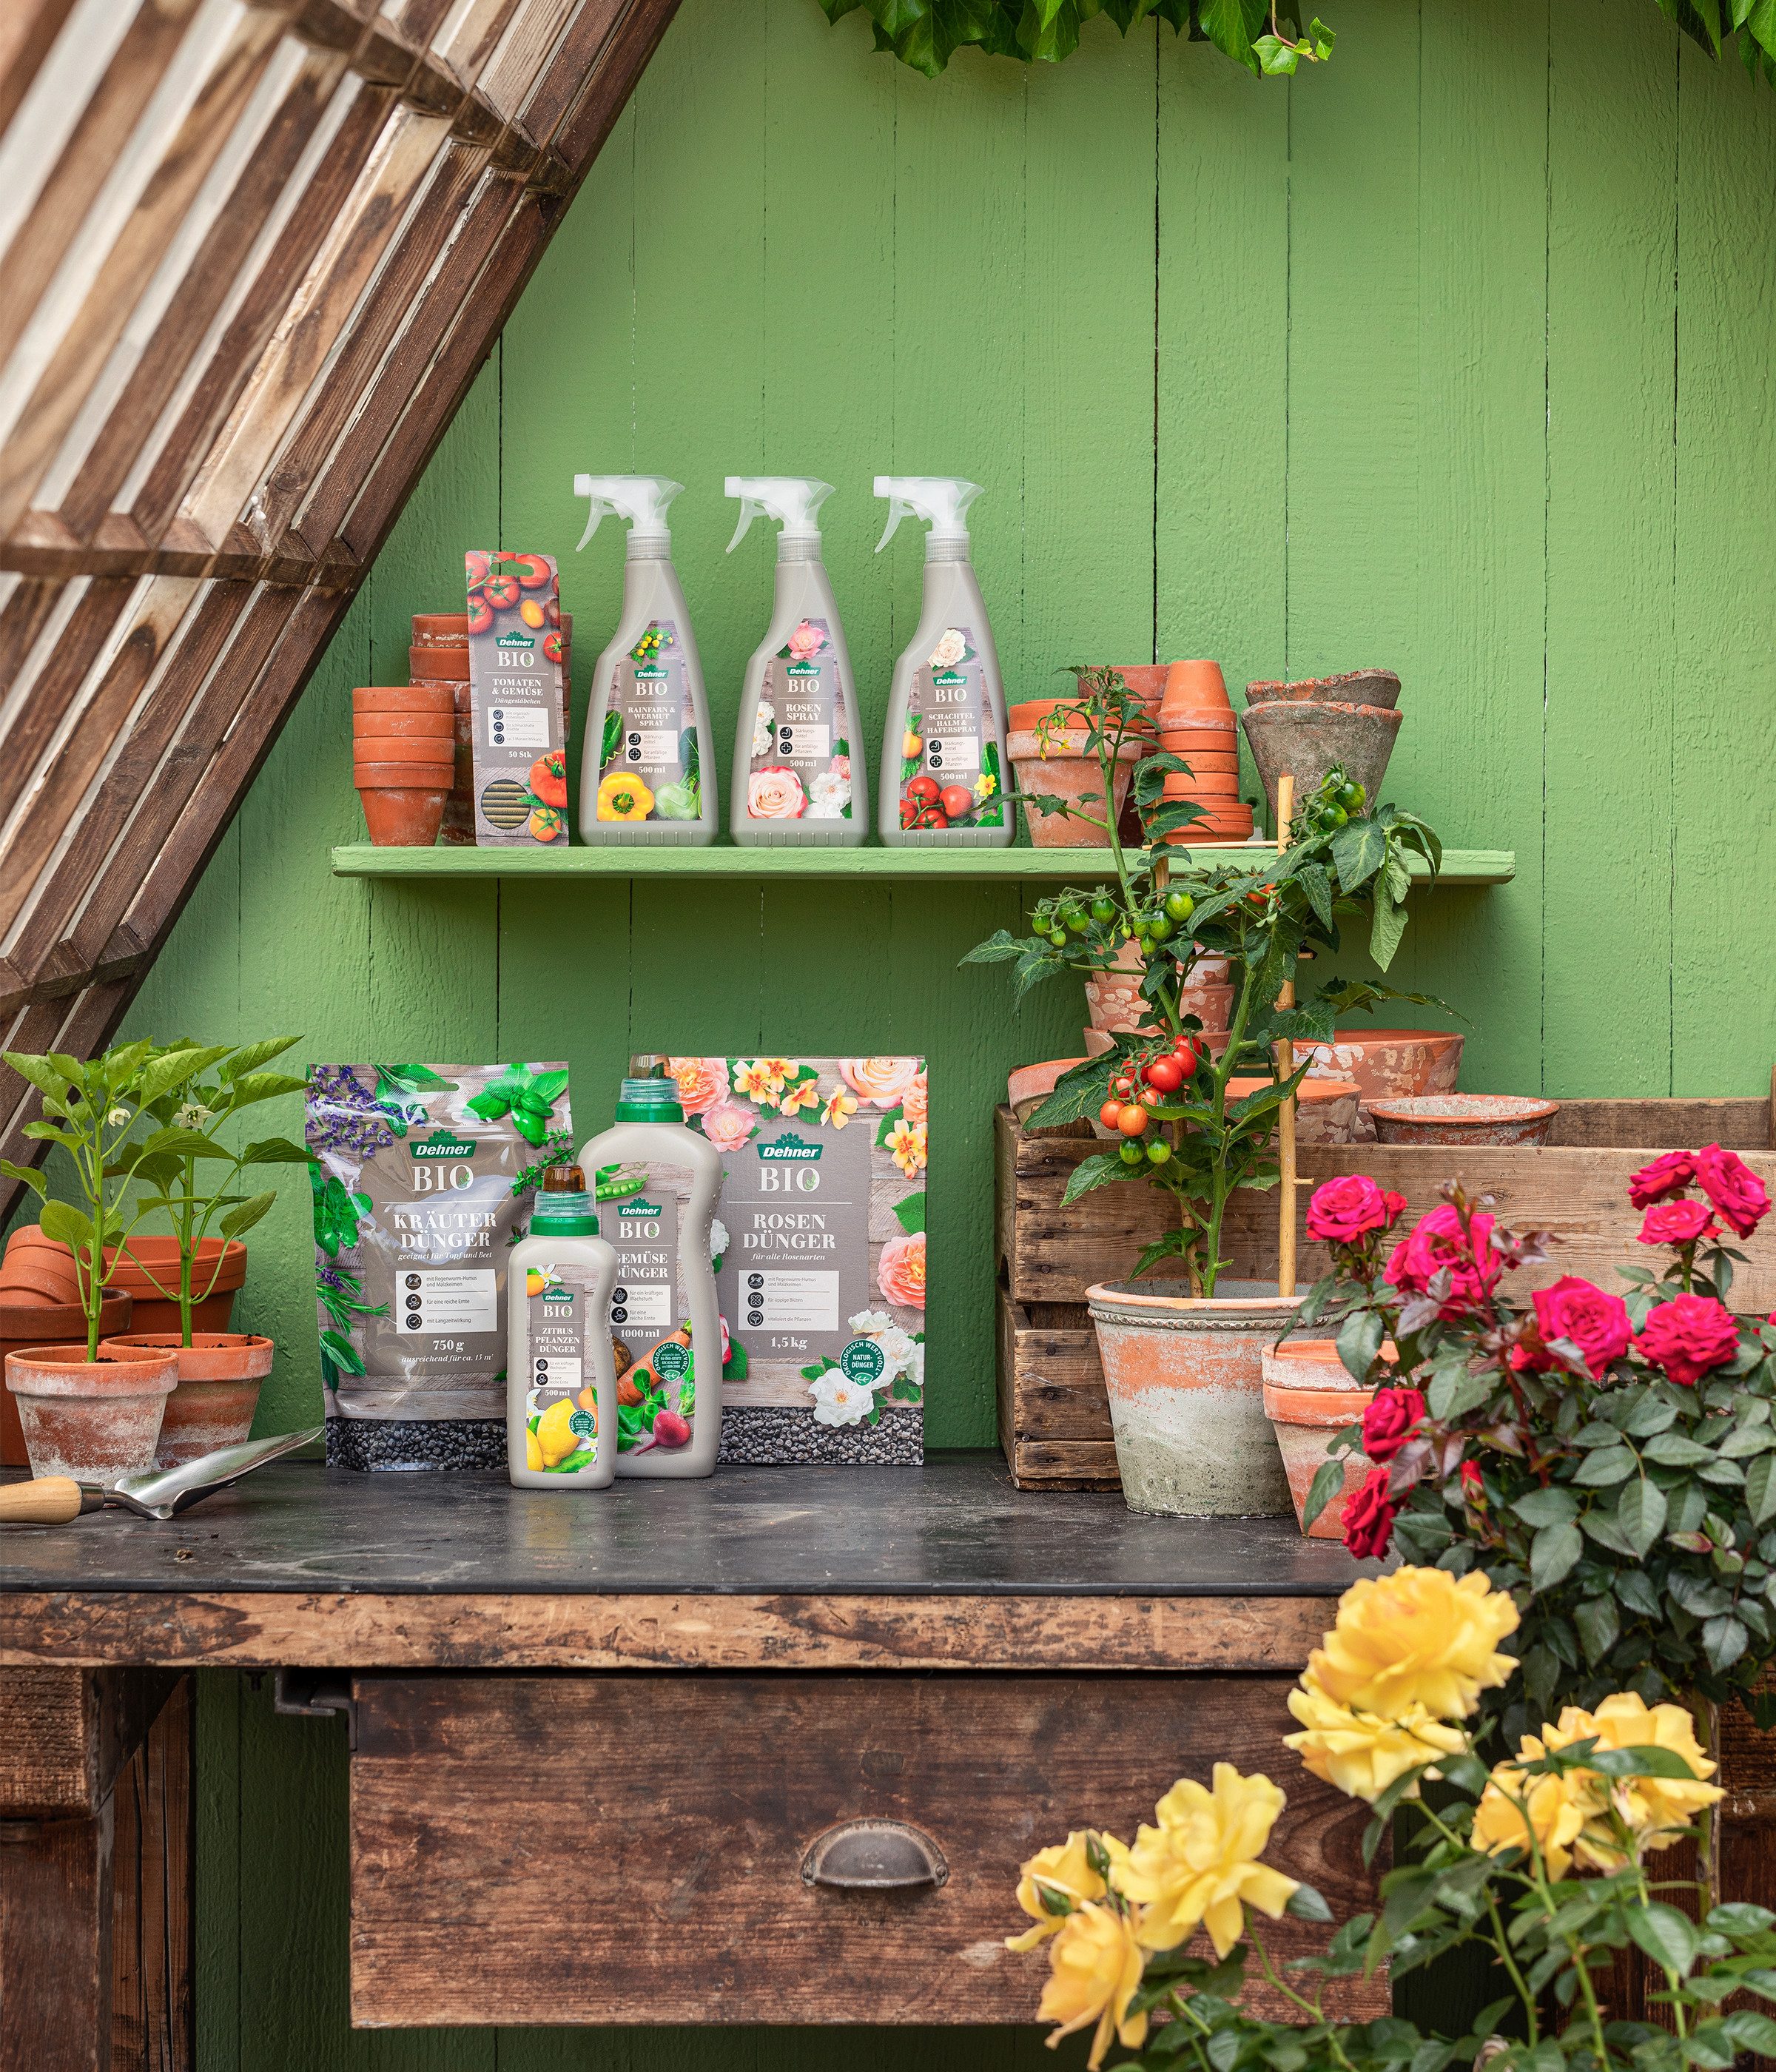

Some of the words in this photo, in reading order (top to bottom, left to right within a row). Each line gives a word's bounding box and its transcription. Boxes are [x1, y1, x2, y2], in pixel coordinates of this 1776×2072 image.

[497, 651, 534, 667] BIO
[492, 678, 542, 687] TOMATEN
[636, 682, 667, 696] BIO
[787, 679, 820, 693] BIO
[502, 687, 543, 696] GEMÜSE
[935, 688, 967, 702] BIO
[786, 704, 821, 712] ROSEN
[787, 712, 820, 721] SPRAY
[519, 750, 532, 758] Stk
[416, 1144, 472, 1156] Dehner
[763, 1146, 819, 1158] Dehner
[411, 1165, 474, 1191] BIO
[758, 1167, 821, 1192] BIO
[622, 1207, 659, 1215] Dehner
[394, 1210, 497, 1229] KRÄUTER
[753, 1214, 827, 1229] ROSEN
[619, 1221, 660, 1239] BIO
[400, 1230, 490, 1248] DÜNGER
[742, 1229, 836, 1249] DÜNGER
[397, 1253, 431, 1261] geeignet
[430, 1252, 443, 1260] für
[618, 1265, 668, 1278] ÜNGER
[543, 1305, 573, 1317] BIO
[621, 1329, 644, 1338] 1000
[645, 1329, 660, 1338] ml
[432, 1339, 454, 1350] 750
[455, 1342, 465, 1353] g
[539, 1344, 576, 1353] DÜNGER
[770, 1336, 789, 1349] 1,5
[790, 1336, 808, 1350] kg
[401, 1355, 448, 1363] ausreichend
[448, 1355, 461, 1363] für
[675, 1345, 688, 1370] WERTVOLL
[866, 1342, 883, 1371] WERTVOLL
[852, 1360, 874, 1368] DÜNGER
